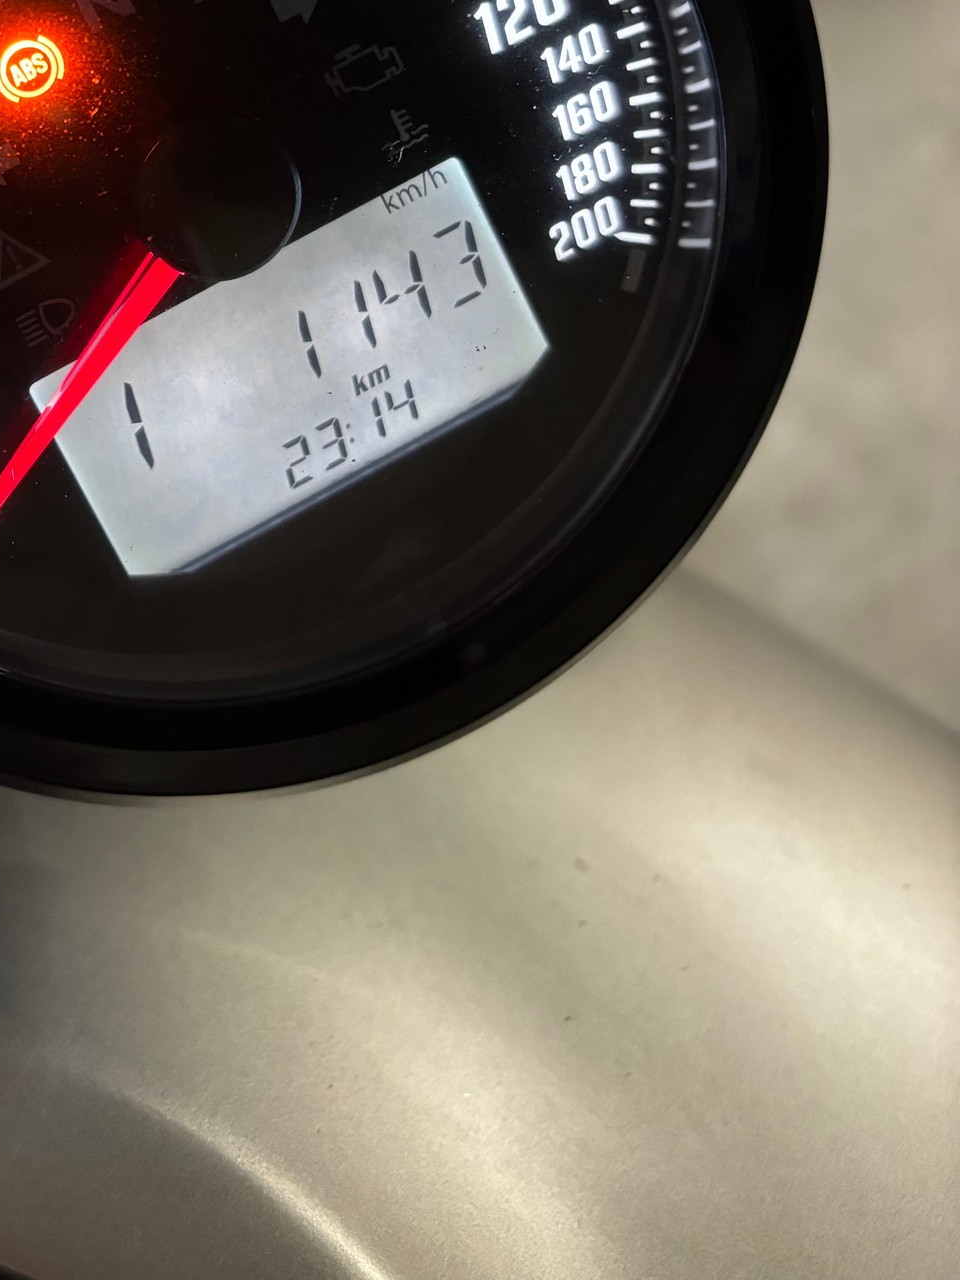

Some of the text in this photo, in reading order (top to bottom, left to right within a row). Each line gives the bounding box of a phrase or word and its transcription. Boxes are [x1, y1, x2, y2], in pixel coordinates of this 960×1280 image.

[8, 52, 50, 88] ABS
[539, 23, 607, 85] 140
[550, 79, 619, 142] 160
[380, 167, 449, 215] km/h
[555, 139, 623, 202] 180
[548, 195, 619, 262] 200
[352, 364, 391, 397] km
[123, 381, 154, 469] 1
[281, 379, 419, 490] 23:14
